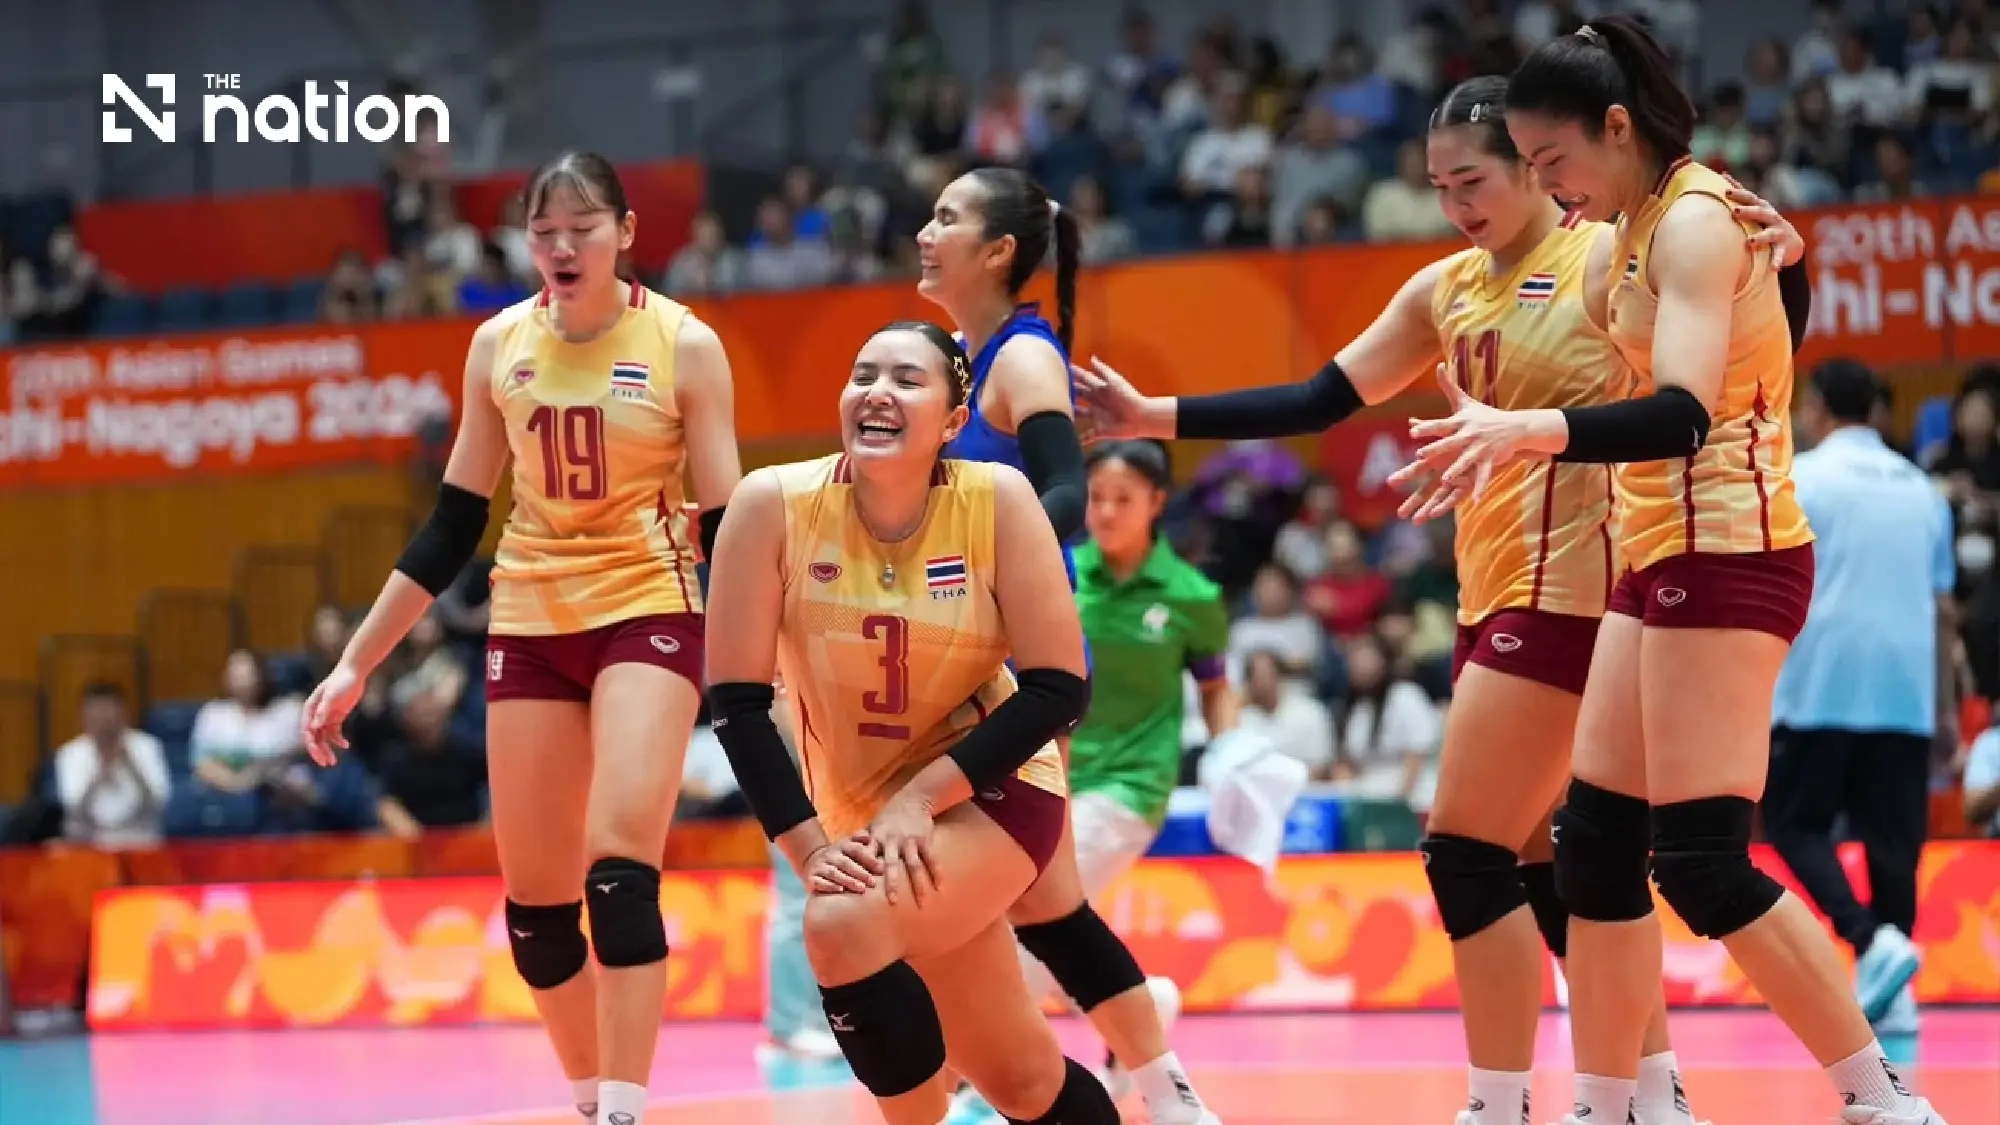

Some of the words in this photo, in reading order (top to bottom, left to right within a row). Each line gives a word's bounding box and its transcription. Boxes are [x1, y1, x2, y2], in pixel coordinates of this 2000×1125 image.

[527, 405, 607, 500] 19
[929, 588, 966, 600] THA
[862, 615, 909, 715] 3
